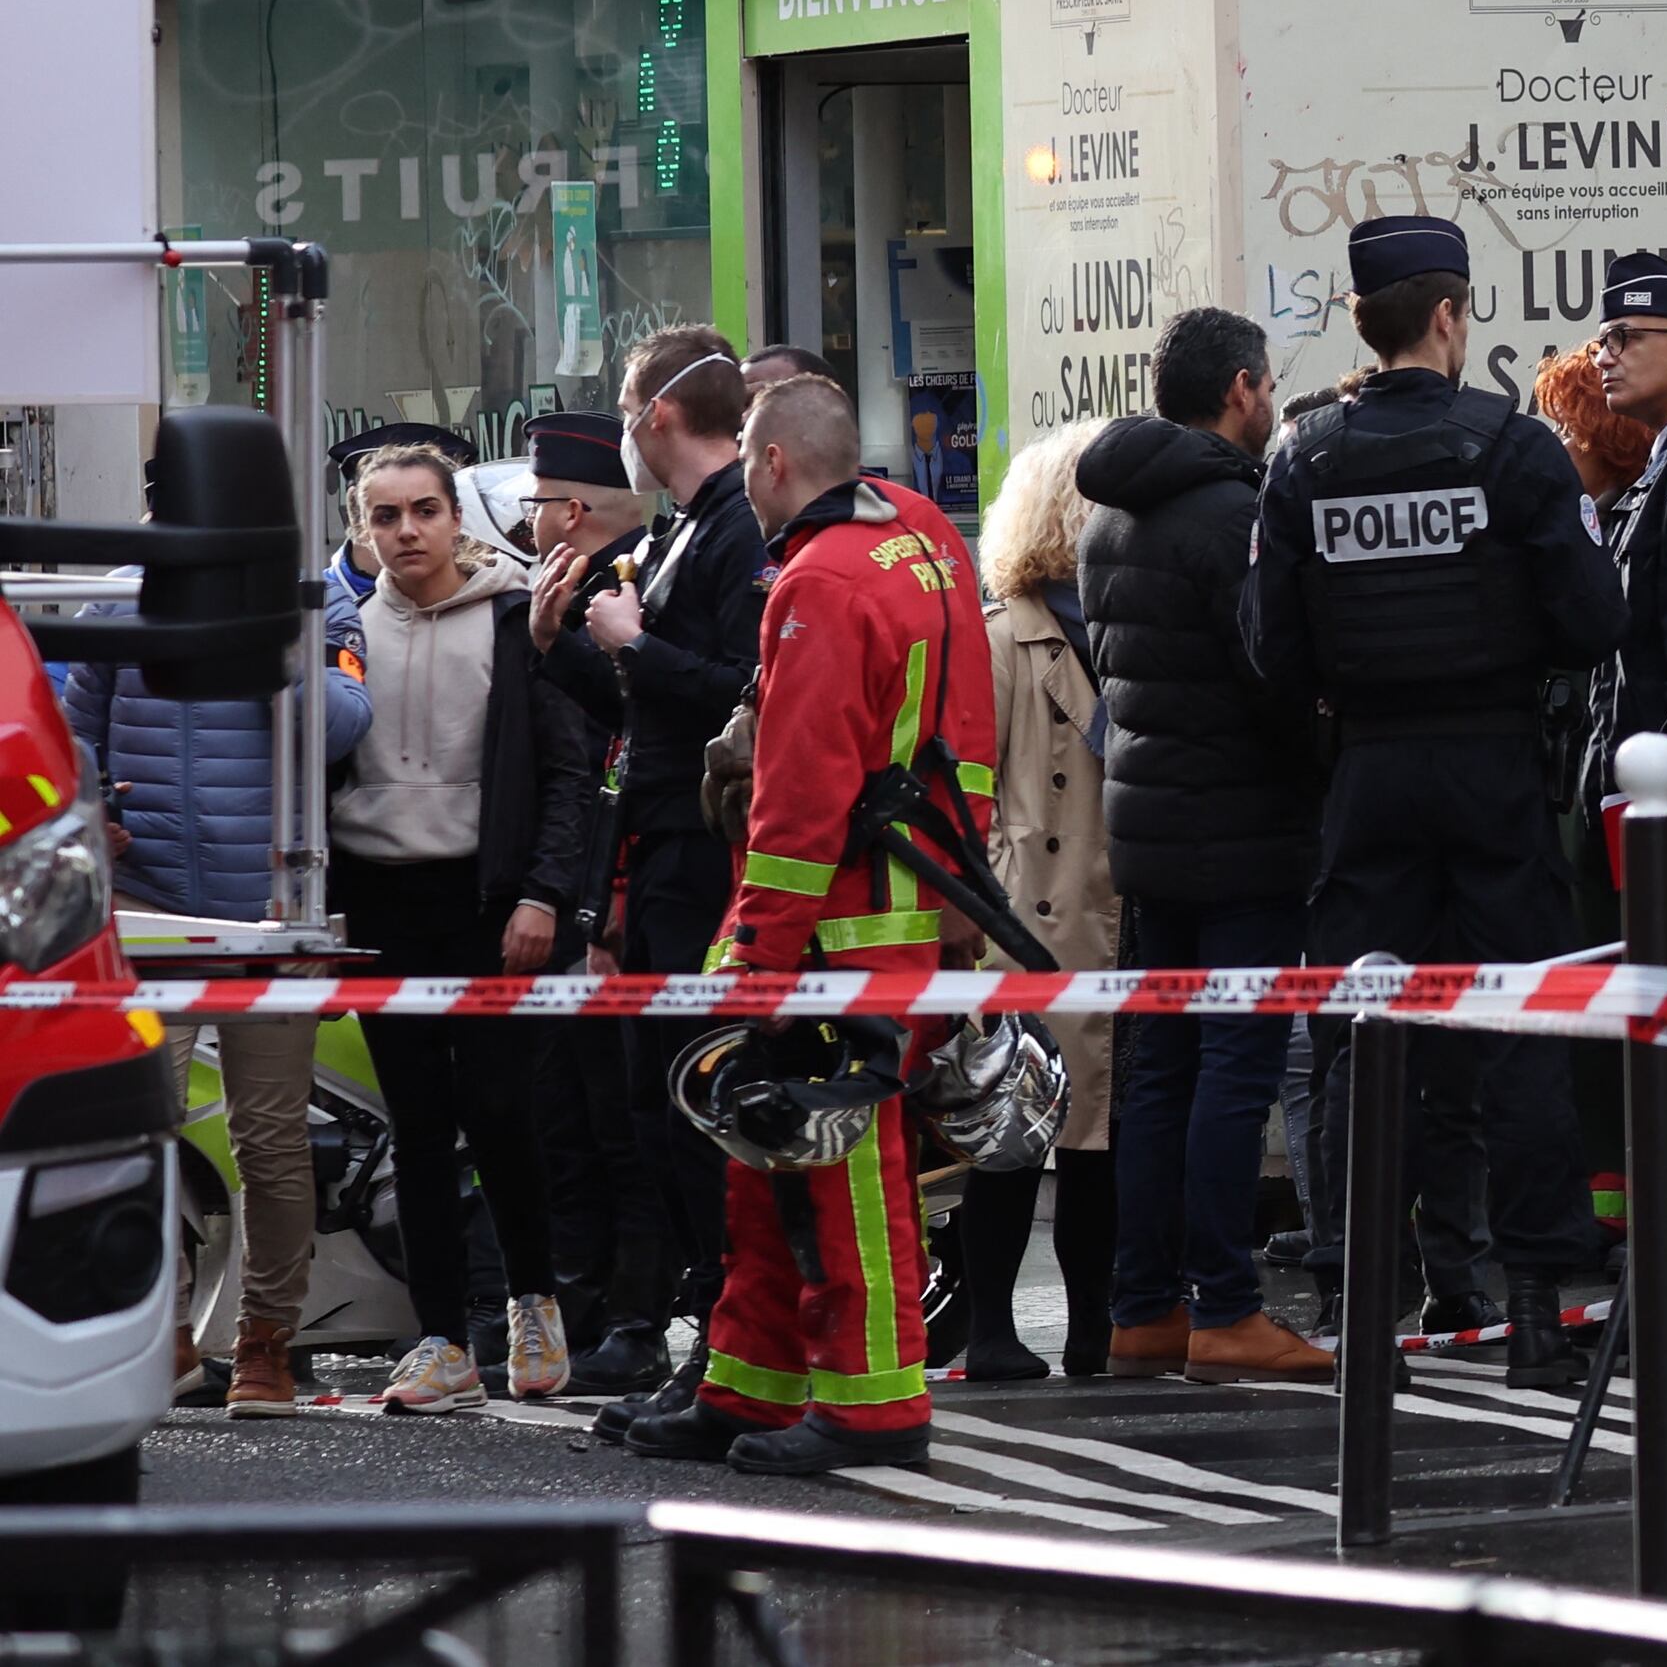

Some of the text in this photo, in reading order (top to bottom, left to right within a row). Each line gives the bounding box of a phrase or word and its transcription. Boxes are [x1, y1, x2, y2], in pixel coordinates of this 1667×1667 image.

[1061, 79, 1123, 116] Docteur
[1499, 67, 1653, 103] Docteur
[1069, 130, 1140, 183] LEVINE
[1457, 123, 1496, 172] J.
[1090, 197, 1105, 209] vous
[1461, 185, 1476, 200] et
[1480, 186, 1507, 200] son
[1511, 183, 1565, 201] équipe
[1569, 186, 1604, 198] vous
[1070, 220, 1083, 233] sans
[1516, 204, 1639, 221] sans interruption
[1040, 284, 1065, 335] du
[1072, 257, 1154, 333] LUNDI
[909, 374, 924, 388] LES
[1032, 389, 1056, 428] au
[1323, 496, 1477, 554] POLICE
